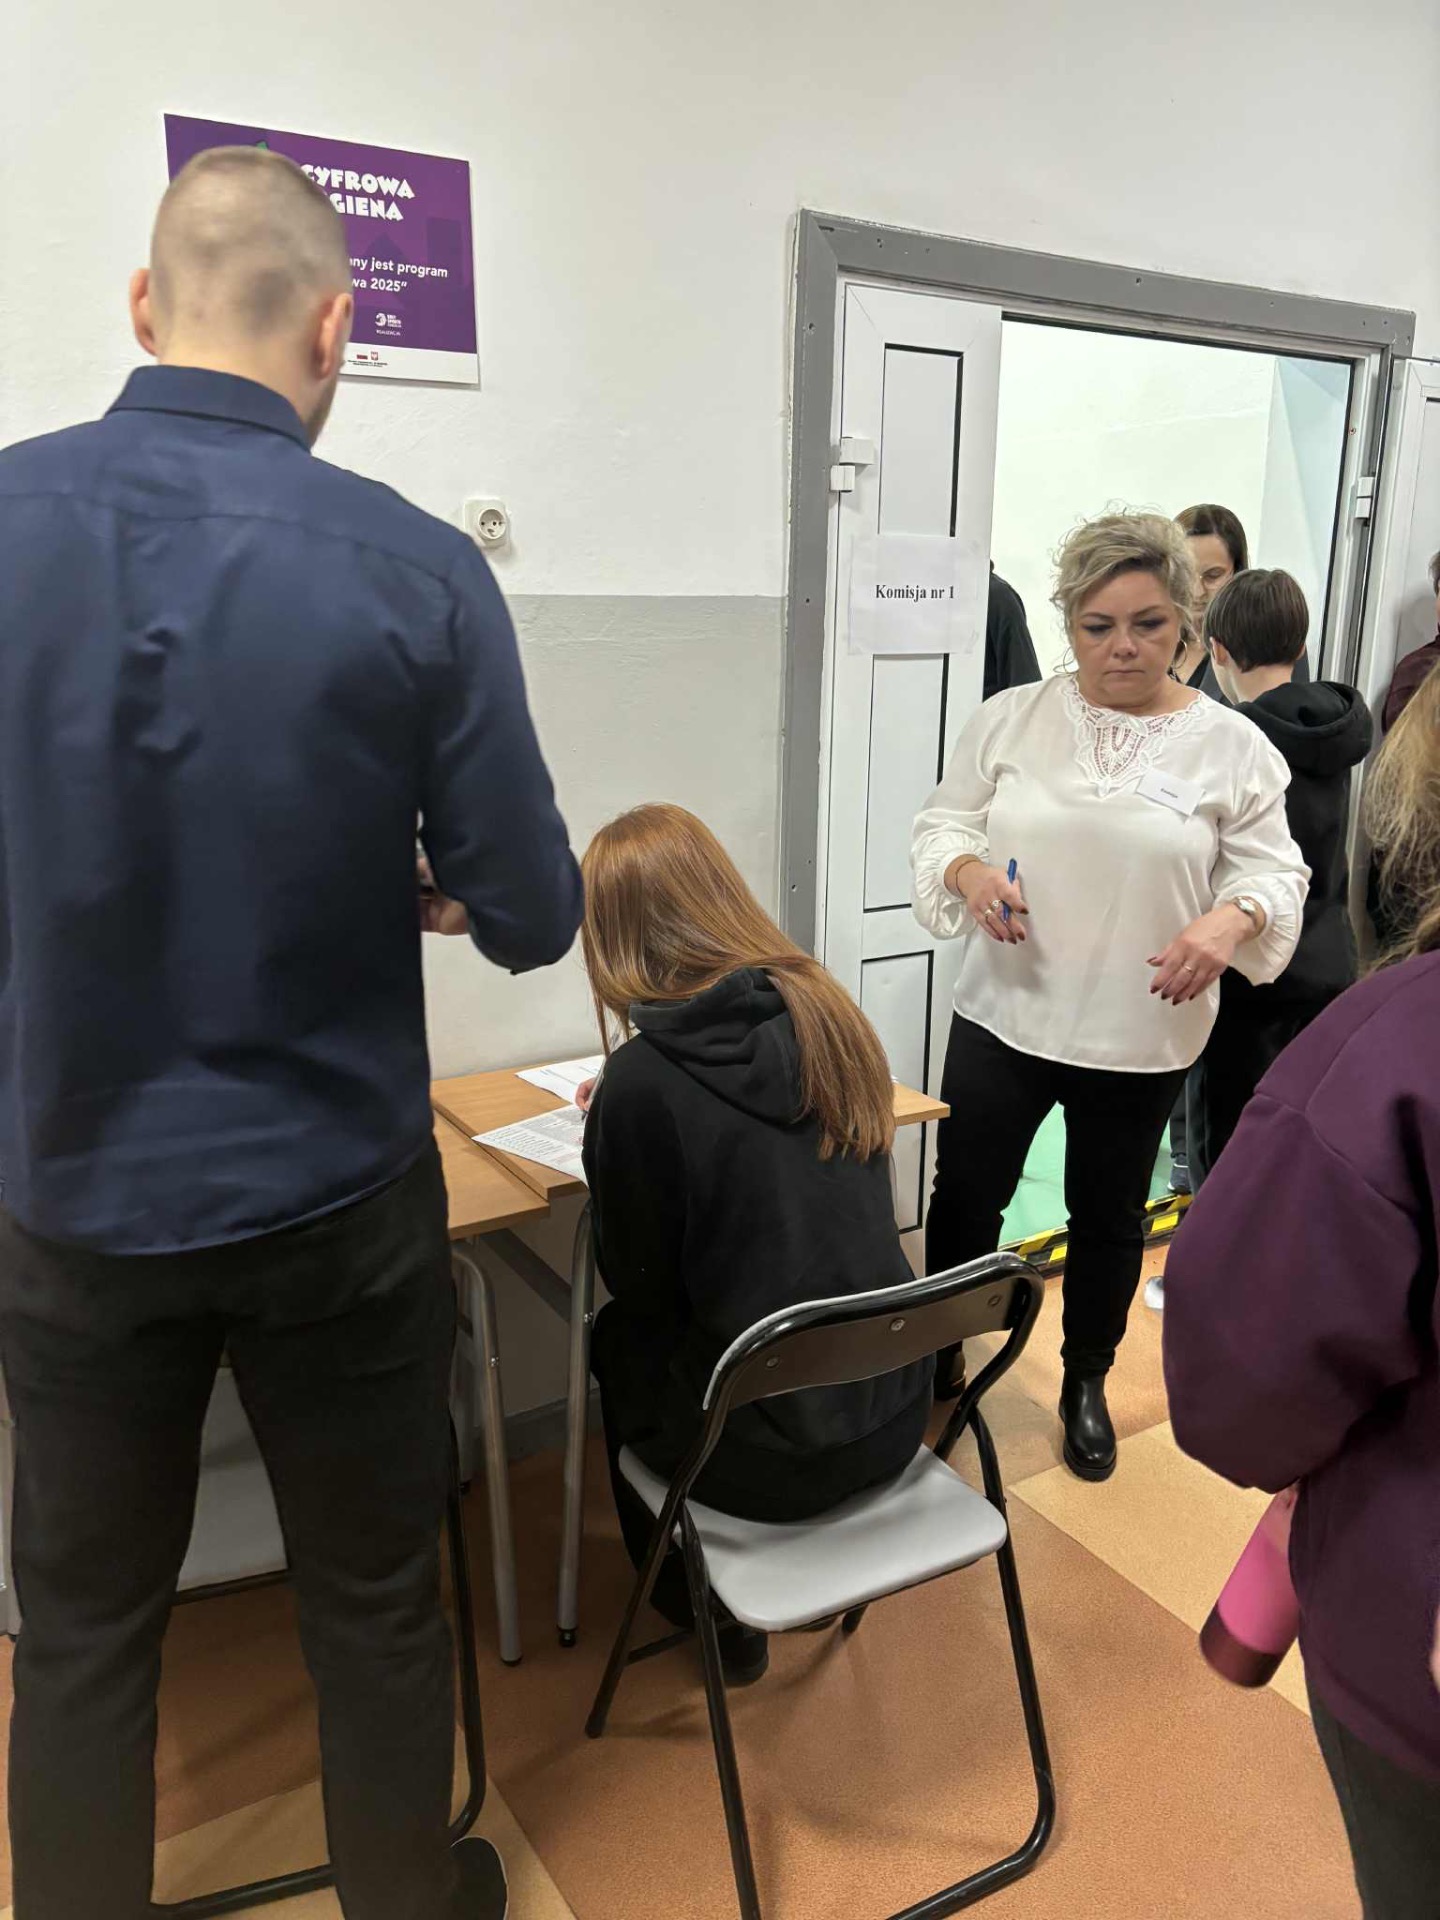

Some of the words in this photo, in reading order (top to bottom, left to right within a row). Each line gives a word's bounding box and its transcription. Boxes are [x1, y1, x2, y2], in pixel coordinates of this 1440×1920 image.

[301, 164, 415, 199] CYFROWA
[330, 193, 404, 220] GIENA
[370, 256, 394, 272] jest
[397, 263, 448, 278] program
[351, 278, 367, 289] wa
[876, 585, 926, 602] Komisja
[930, 589, 945, 599] nr
[949, 586, 954, 598] 1
